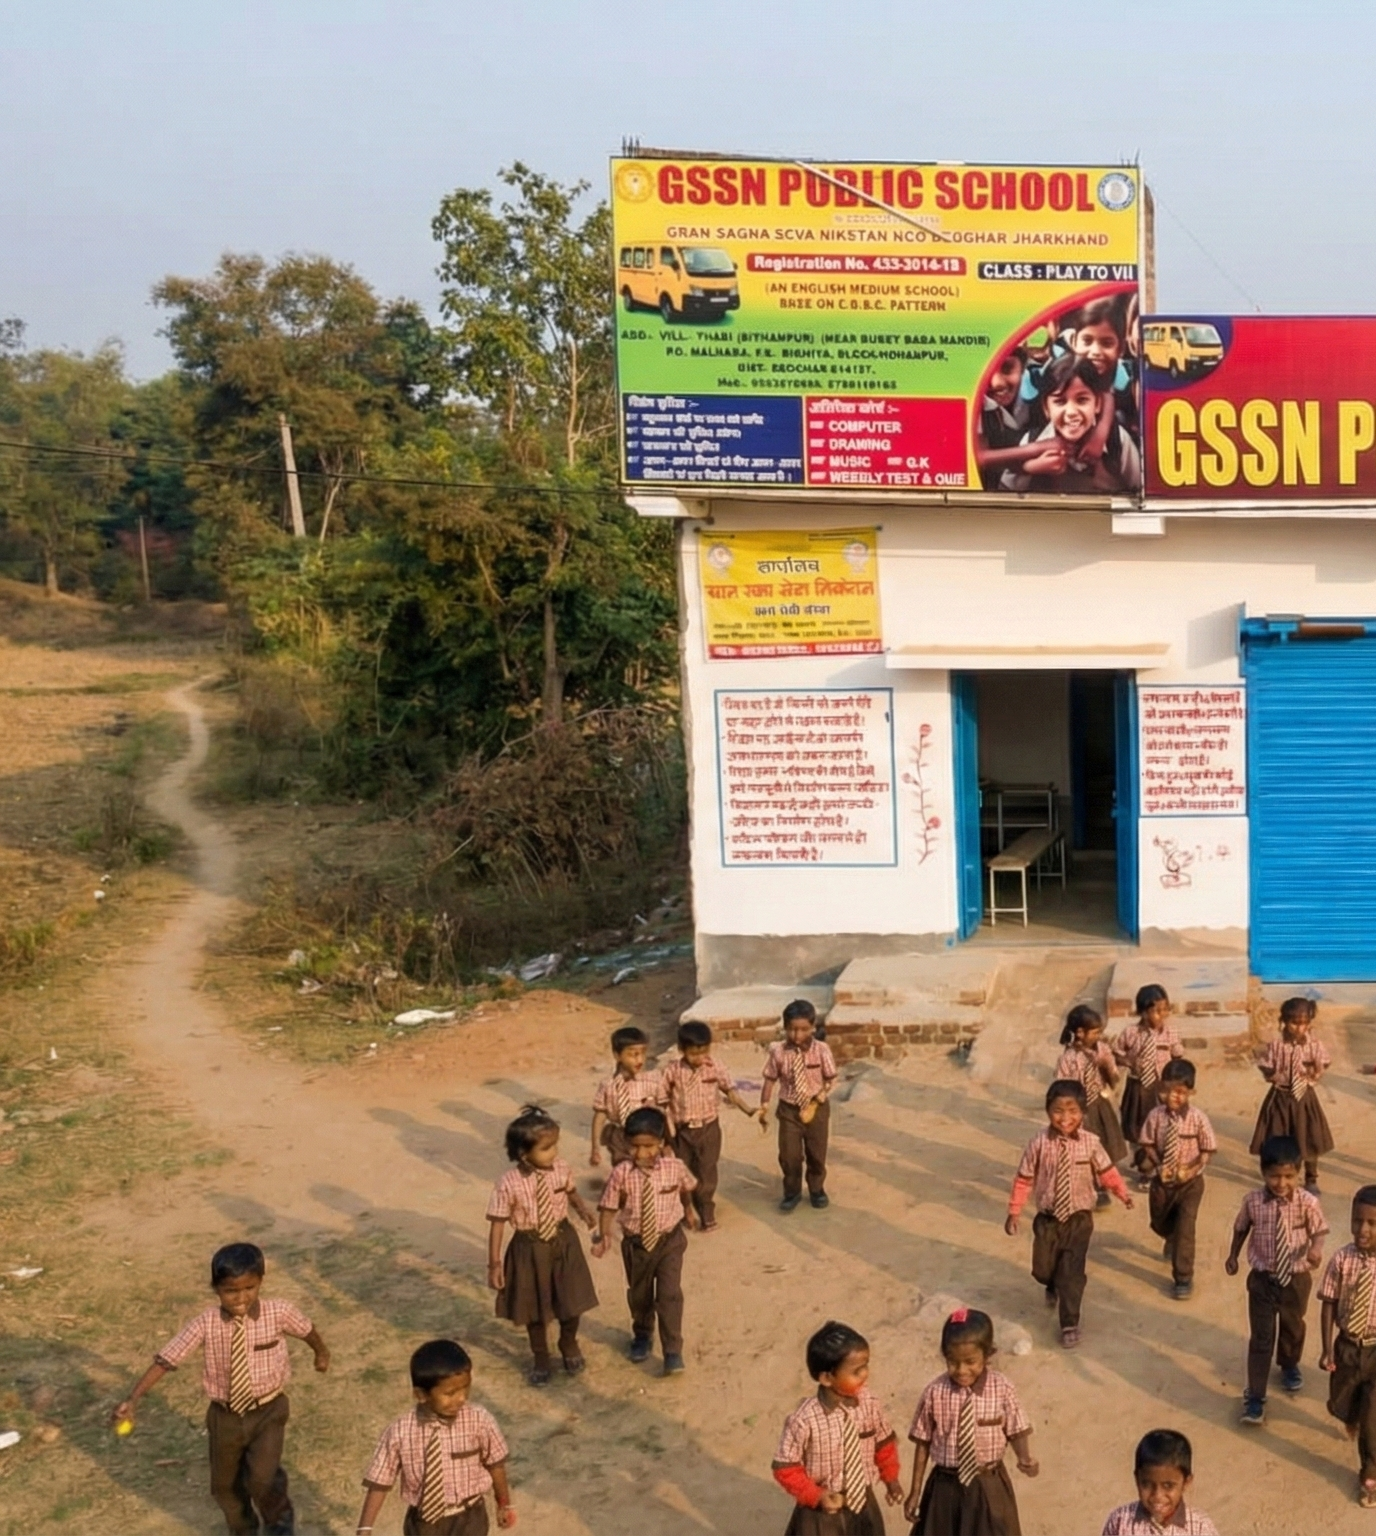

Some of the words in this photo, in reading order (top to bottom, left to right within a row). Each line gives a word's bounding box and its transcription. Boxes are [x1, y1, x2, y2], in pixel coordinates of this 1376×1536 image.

[657, 165, 767, 206] GSSN
[779, 168, 923, 209] PUBLIC
[934, 169, 1095, 212] SCHOOL
[667, 227, 710, 240] GRAN
[716, 228, 769, 240] SAGNA
[1013, 232, 1109, 246] JHARKHAND
[845, 258, 869, 270] No.
[983, 264, 1033, 280] CLASS
[1046, 265, 1084, 280] PLAY
[1087, 265, 1108, 280] TO
[791, 283, 846, 295] ENGLISH
[850, 284, 900, 296] MEDIUM
[904, 285, 960, 298] SCHOOL)
[816, 299, 834, 310] ON
[828, 420, 902, 433] COMPUTER
[1156, 398, 1322, 488] GSSN
[829, 455, 871, 467] MUSIC
[886, 472, 919, 484] TEST
